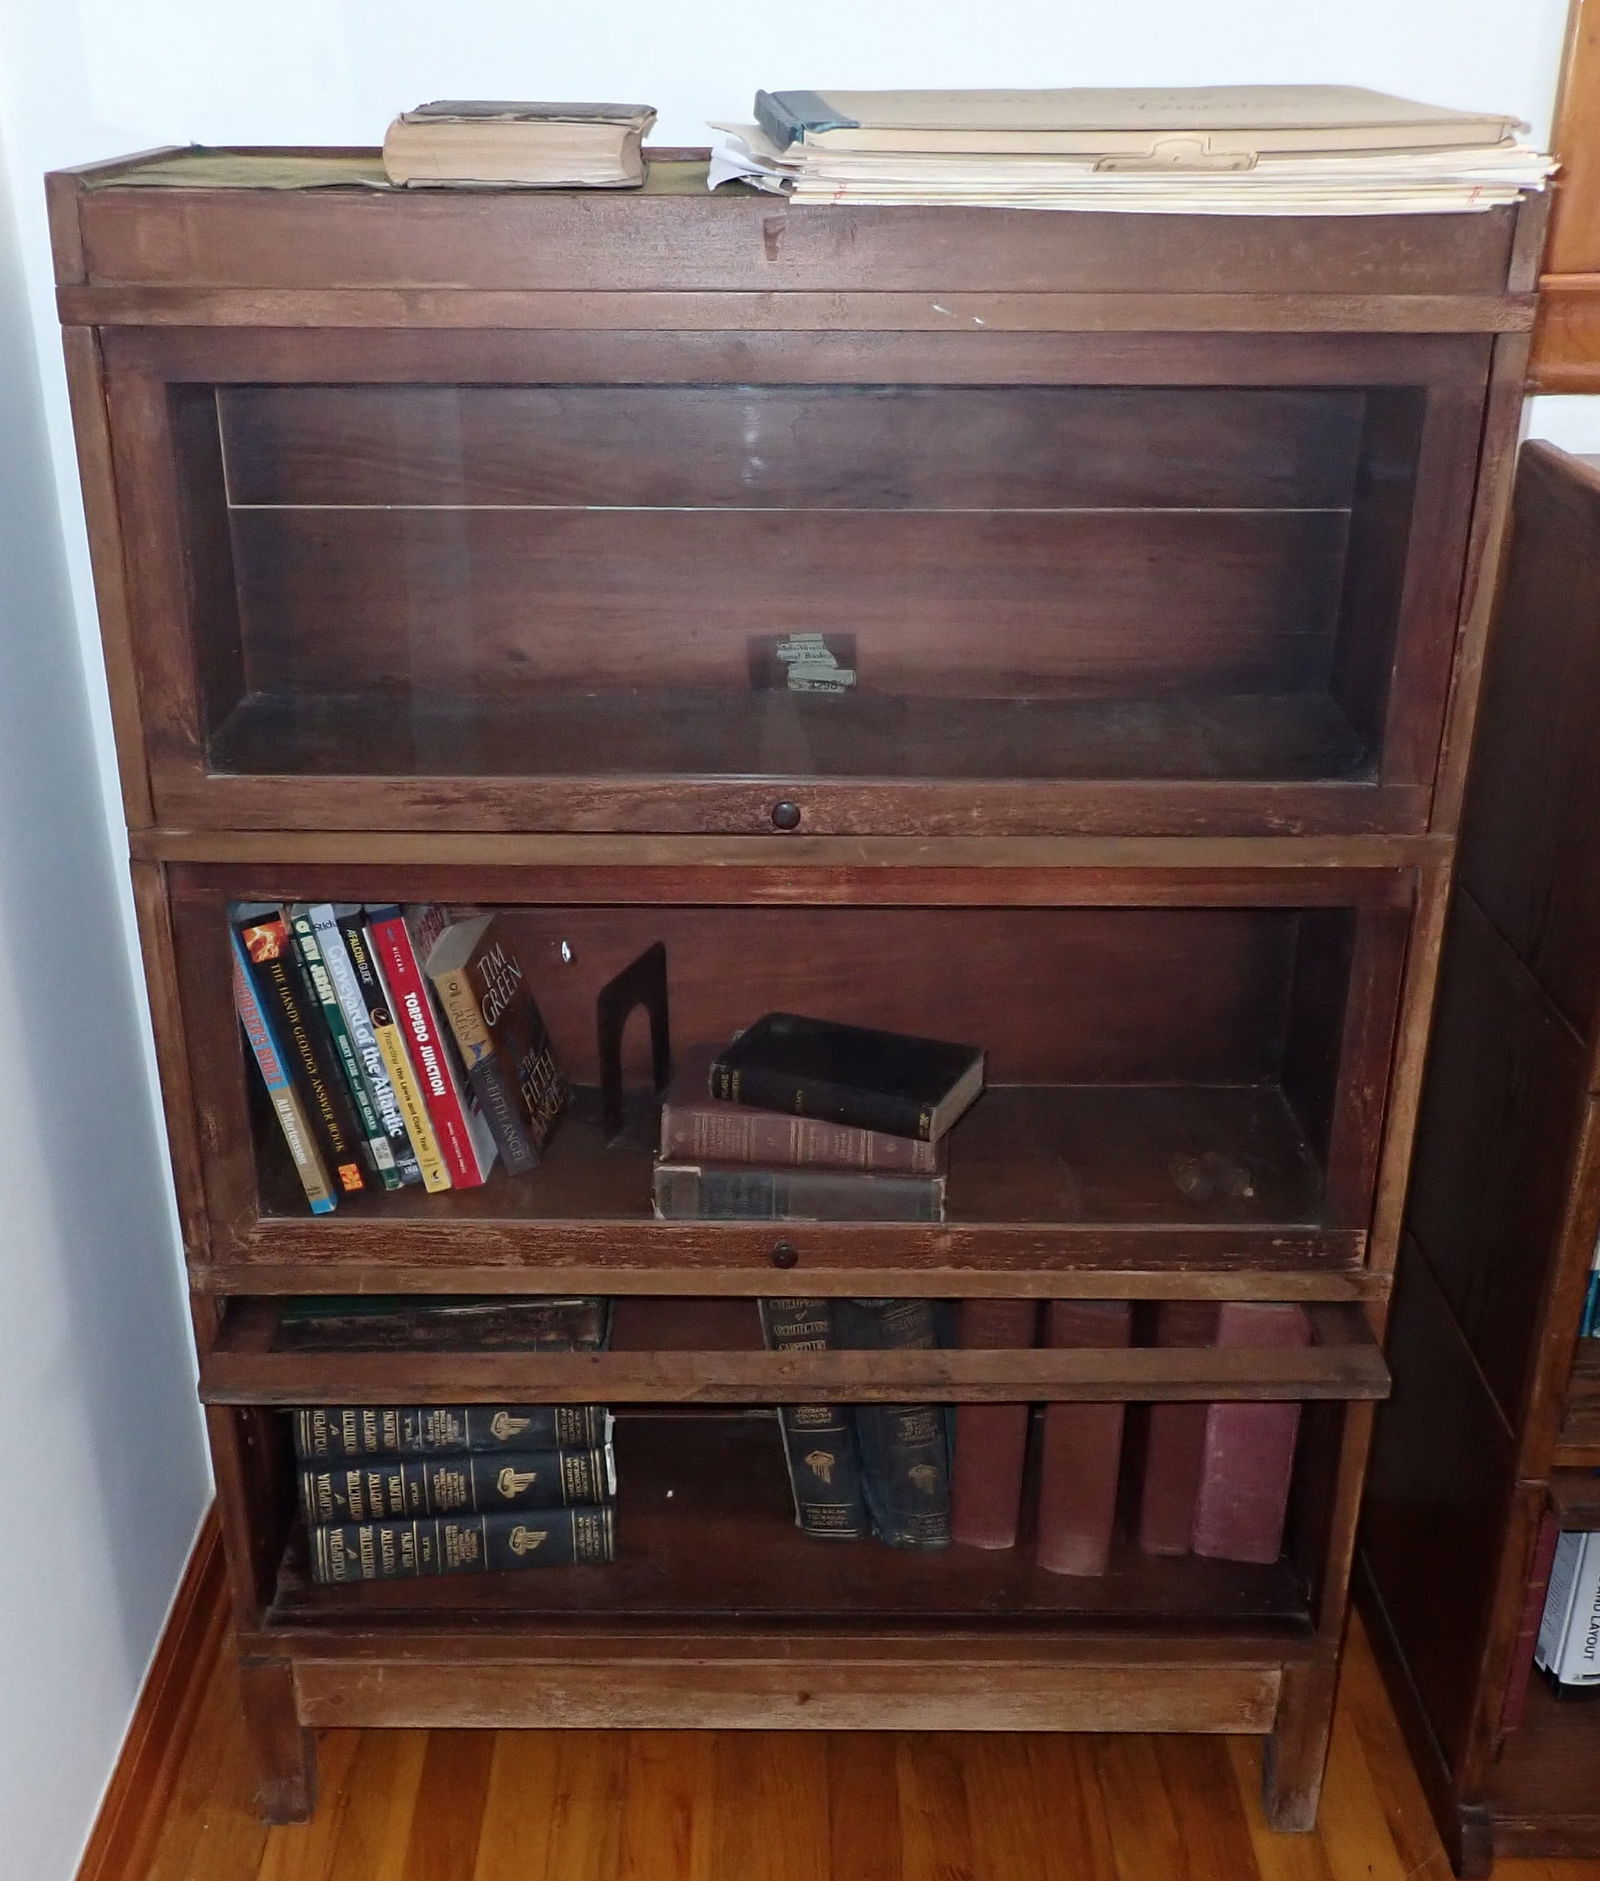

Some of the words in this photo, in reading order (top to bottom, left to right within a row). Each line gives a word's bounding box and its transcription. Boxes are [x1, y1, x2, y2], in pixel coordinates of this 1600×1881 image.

[300, 935, 321, 961] NEW
[477, 941, 506, 988] TIM
[310, 964, 337, 1005] JERSEY
[327, 945, 371, 1027] Graveyard
[482, 955, 523, 1026] GREEN
[271, 962, 286, 983] THE
[279, 986, 301, 1023] HANDY
[293, 1026, 319, 1075] GEOLOGY
[311, 1077, 334, 1121] ANSWER
[326, 1121, 346, 1153] BOOK
[356, 1028, 376, 1047] of
[362, 1047, 381, 1074] the
[404, 991, 430, 1042] TORPEDO
[420, 1045, 447, 1097] JUNCTION
[337, 1033, 352, 1058] ROBERT
[363, 1106, 378, 1131] GILMAN
[521, 1048, 555, 1113] FIFTH
[373, 1077, 404, 1138] Atlantic
[395, 1067, 404, 1080] the
[400, 1080, 411, 1102] Lewis
[407, 1102, 417, 1117] and
[412, 1115, 423, 1135] Clark
[420, 1137, 430, 1152] Trail
[503, 1123, 526, 1161] ANGEL
[342, 1410, 358, 1456] ARCHITECTU
[362, 1410, 378, 1453] CARPENTR
[388, 1475, 403, 1513] BUILDING
[329, 1528, 346, 1581] CYCLOPEDIA
[359, 1526, 376, 1579] ARCHITECTURE
[380, 1528, 395, 1575] CARPENTRY
[401, 1532, 414, 1569] BUILDING
[1583, 1615, 1600, 1661] LAYOUT
